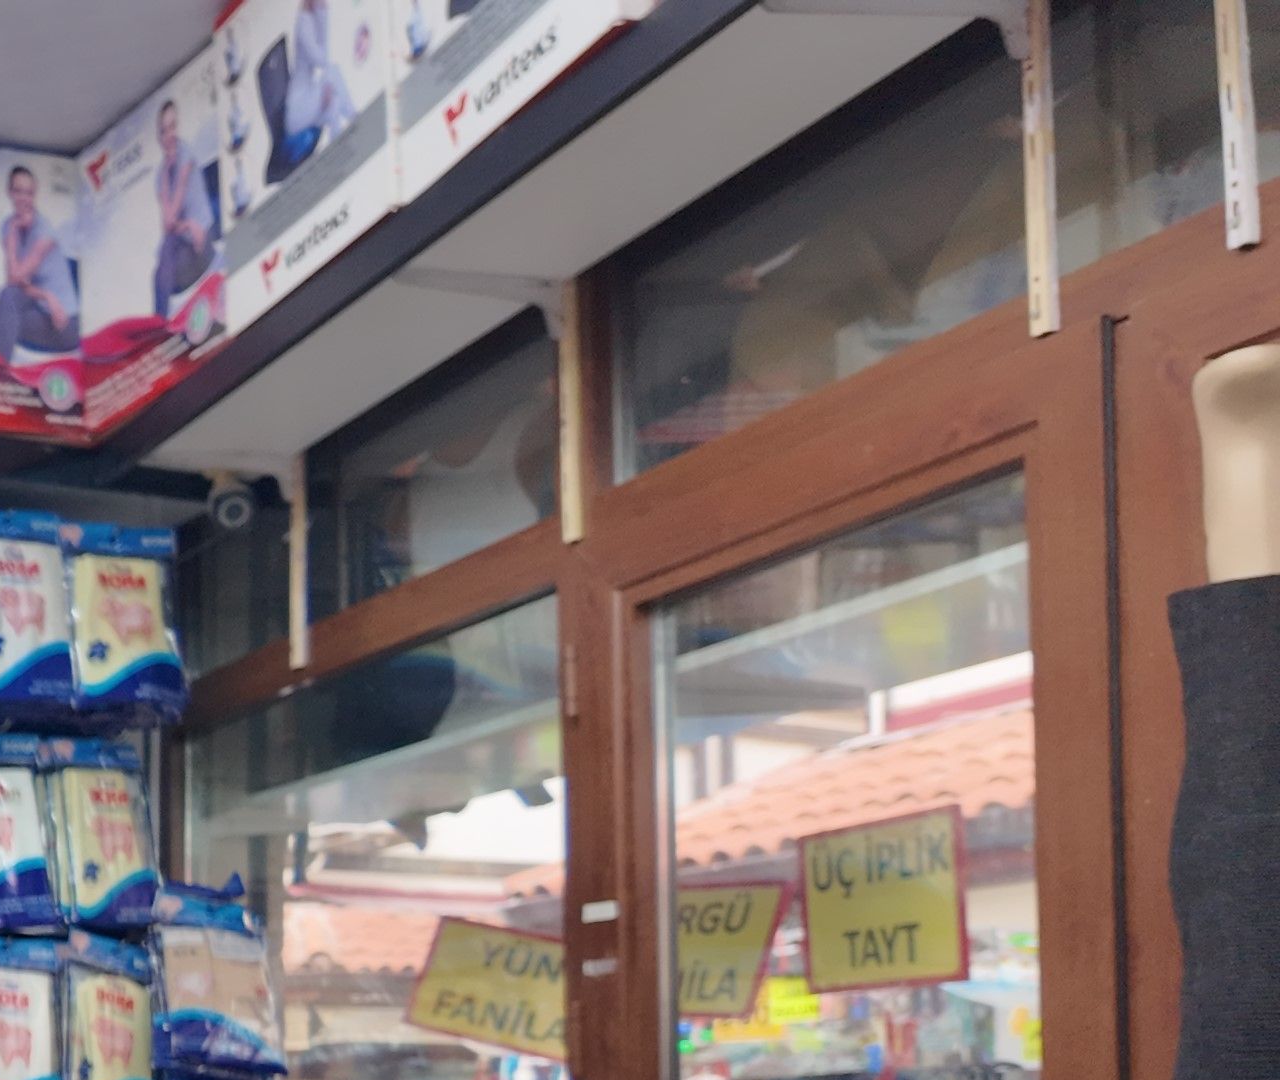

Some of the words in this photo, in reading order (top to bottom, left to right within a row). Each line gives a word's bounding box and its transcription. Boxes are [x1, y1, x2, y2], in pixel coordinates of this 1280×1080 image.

[811, 834, 855, 898] ÜÇ
[865, 828, 949, 885] İPLİK
[678, 895, 750, 938] RGÜ
[481, 934, 564, 980] YÜN
[842, 922, 920, 969] TAYT
